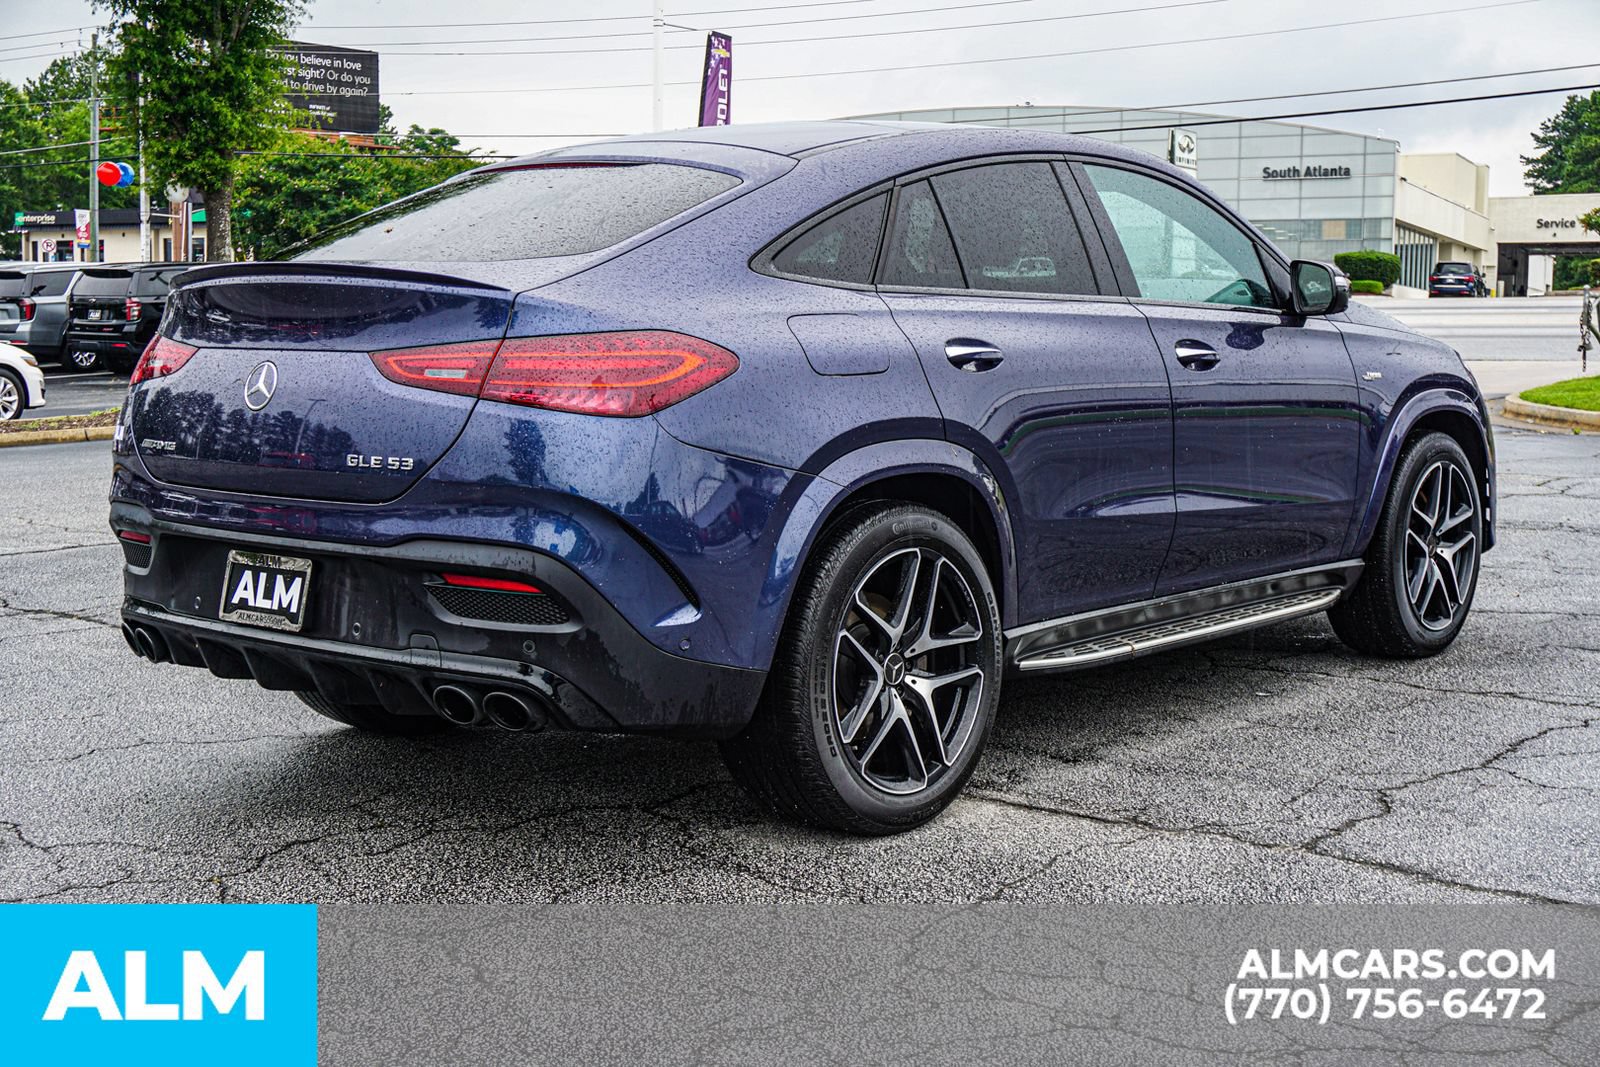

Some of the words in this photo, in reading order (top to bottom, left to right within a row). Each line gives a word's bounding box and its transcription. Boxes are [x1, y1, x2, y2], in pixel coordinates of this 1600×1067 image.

[300, 53, 331, 66] believe
[333, 57, 342, 68] in
[343, 58, 362, 71] love
[297, 67, 325, 80] sight?
[327, 70, 339, 80] Or
[341, 71, 353, 82] do
[354, 75, 371, 85] you
[290, 79, 301, 89] to
[302, 81, 324, 92] drive
[326, 83, 338, 95] by
[339, 86, 369, 97] again?
[1262, 165, 1301, 179] South
[1303, 165, 1351, 178] Atlanta
[17, 214, 56, 224] enterprise
[1536, 218, 1576, 229] Service
[147, 439, 177, 451] AMG
[346, 453, 383, 469] GLE
[387, 456, 414, 471] 53
[231, 570, 303, 614] ALM
